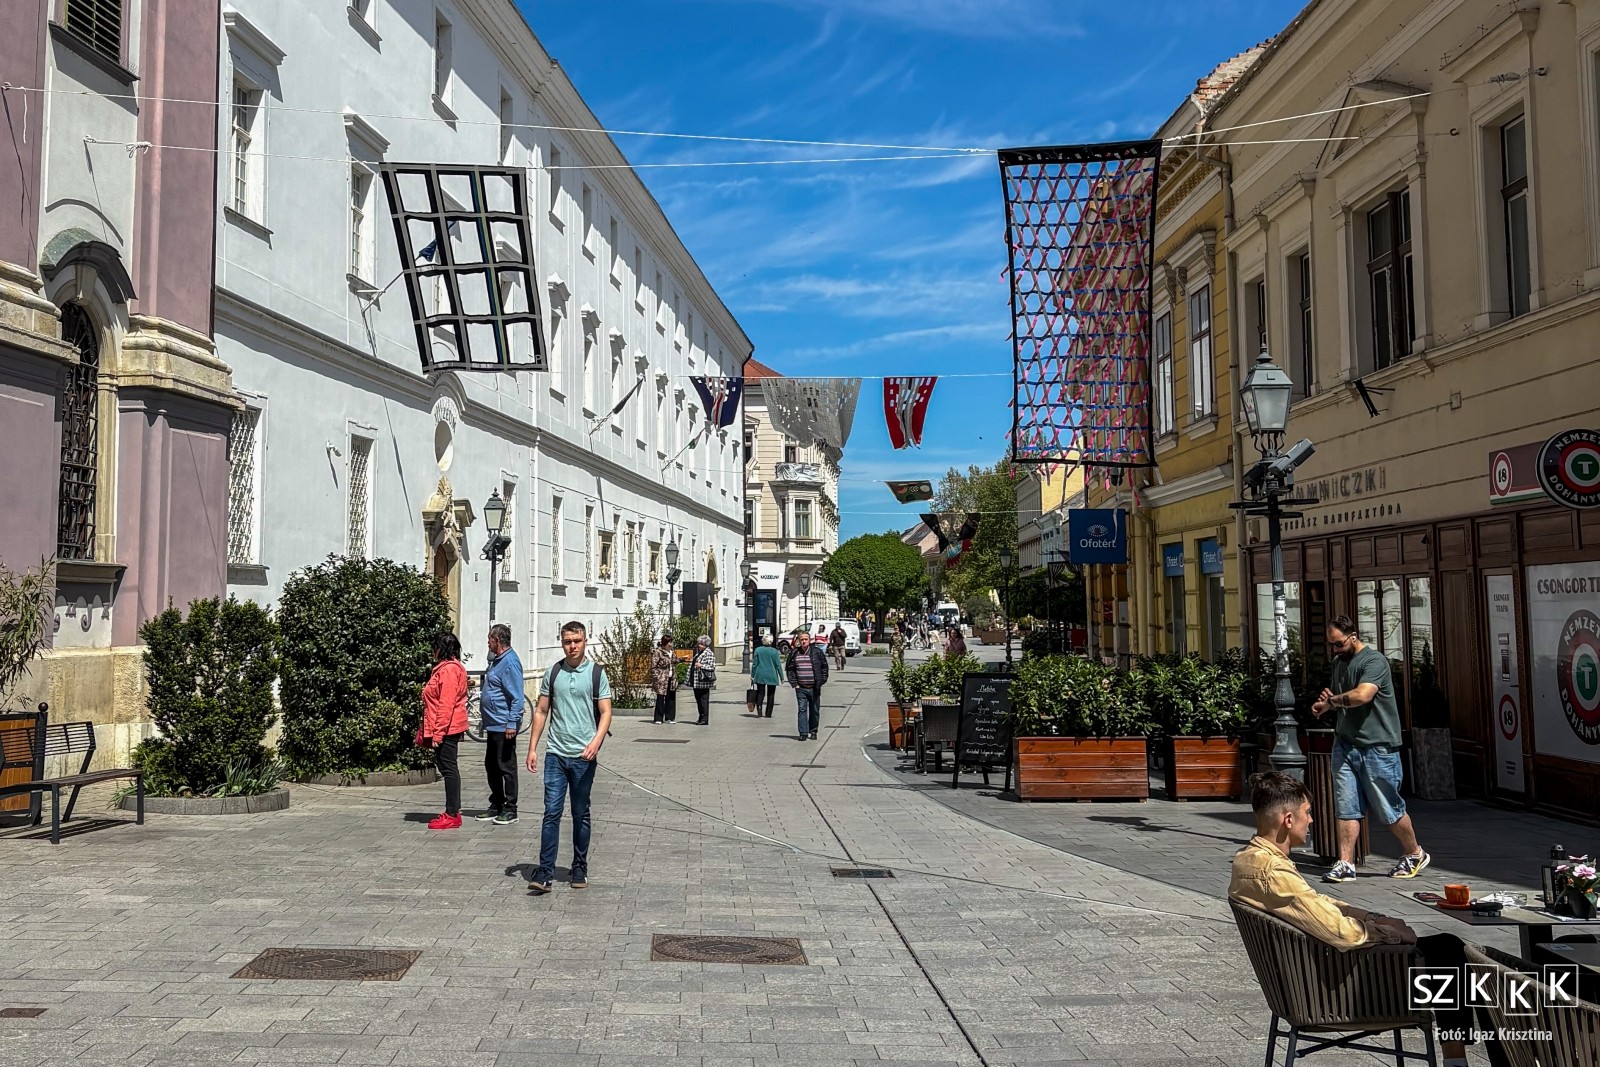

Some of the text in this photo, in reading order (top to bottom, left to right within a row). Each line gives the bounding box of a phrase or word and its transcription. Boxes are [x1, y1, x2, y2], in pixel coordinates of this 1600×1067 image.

[1498, 468, 1507, 483] 18
[1577, 461, 1593, 475] T
[1549, 475, 1600, 504] DOHÁNY
[1079, 538, 1117, 549] Ofotért
[1537, 577, 1587, 595] CSONGOR
[1580, 666, 1593, 690] T
[1503, 710, 1513, 726] 18
